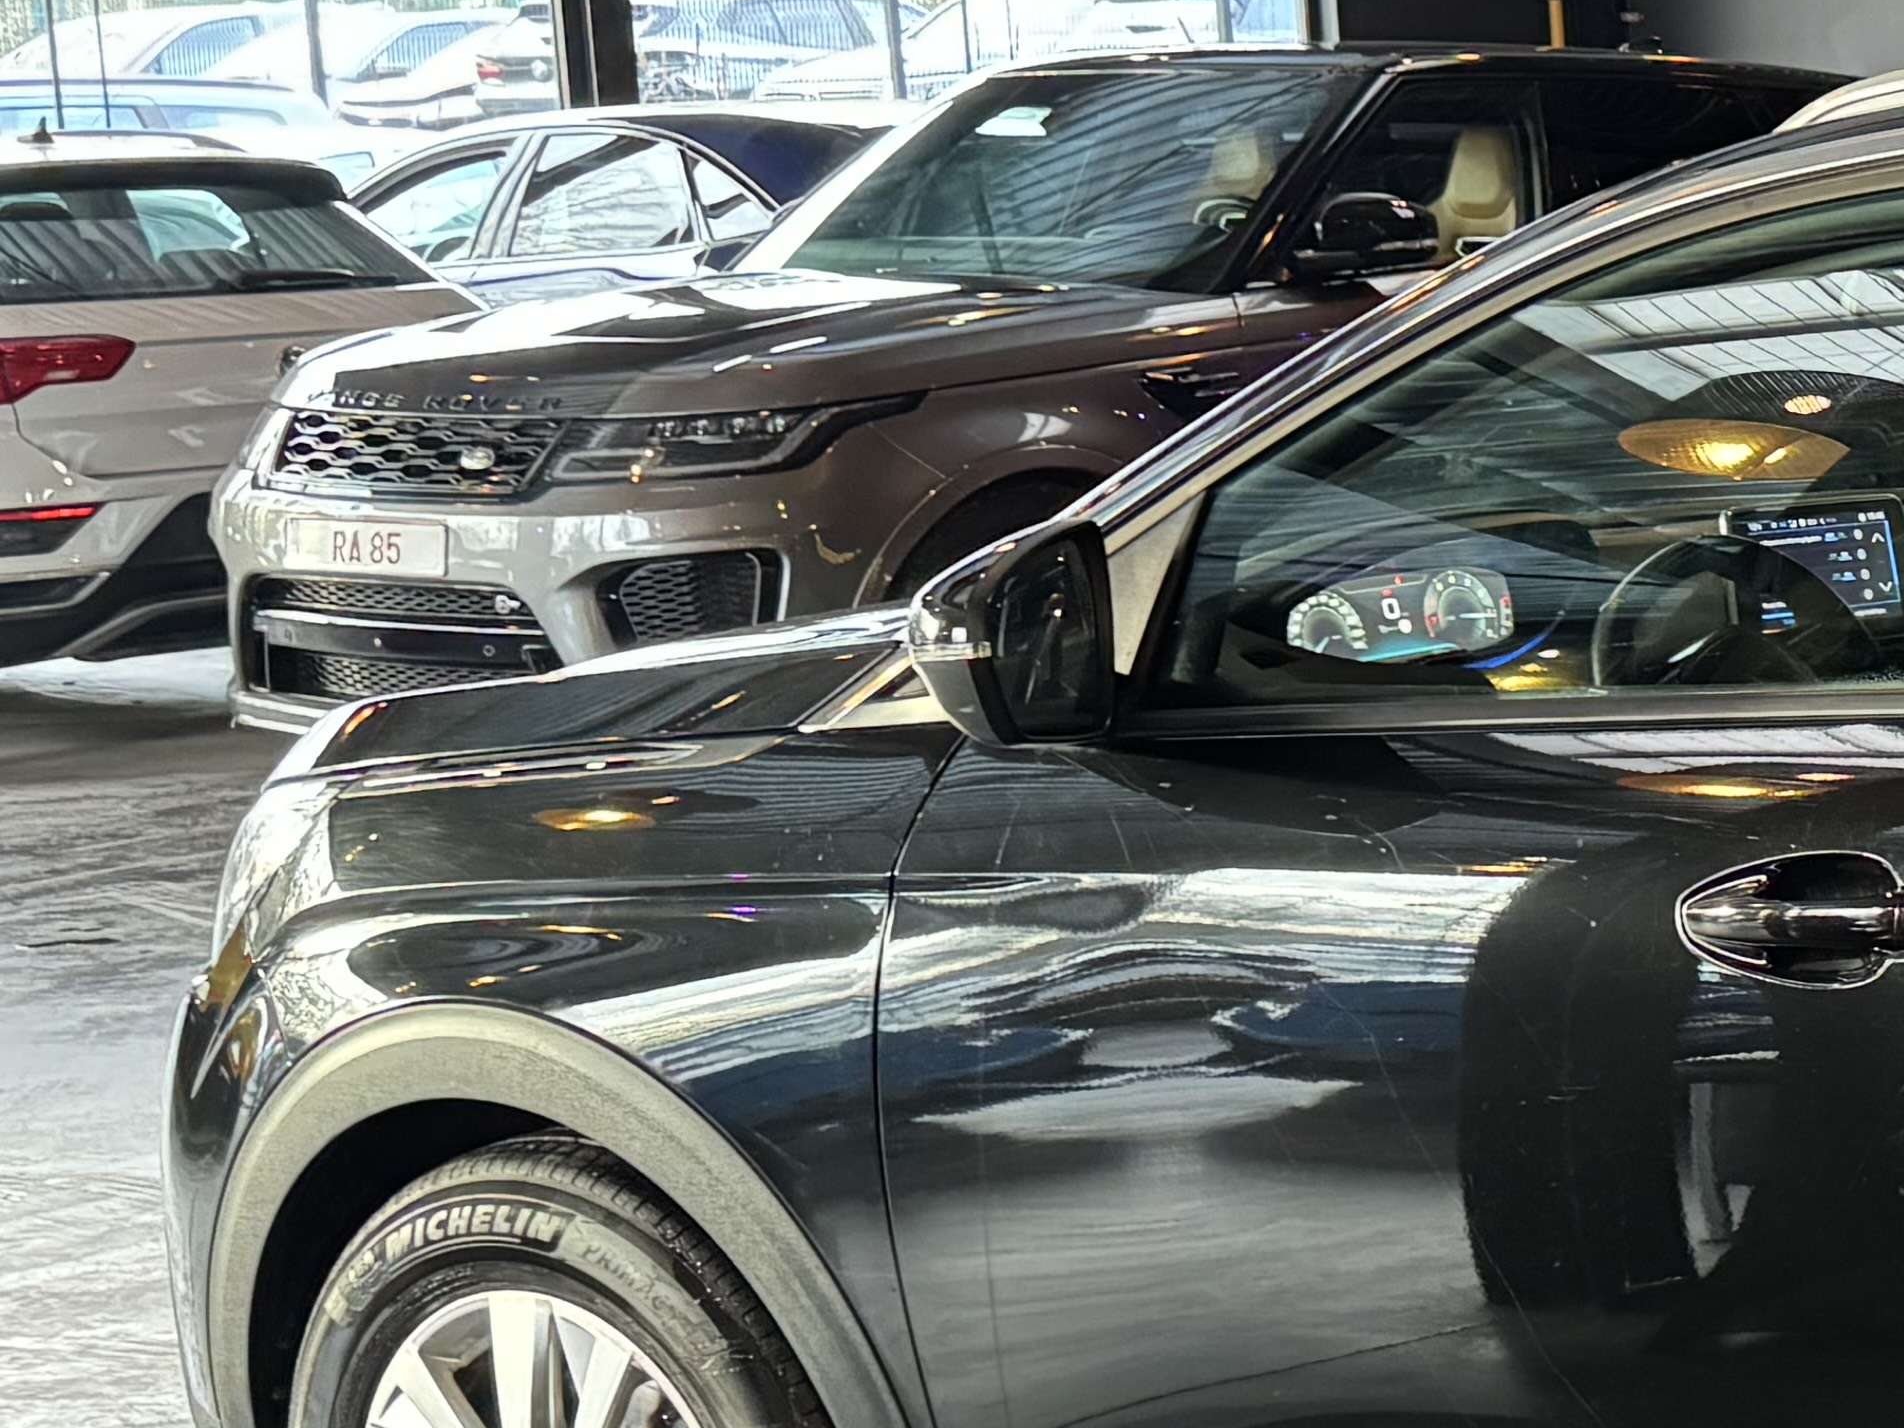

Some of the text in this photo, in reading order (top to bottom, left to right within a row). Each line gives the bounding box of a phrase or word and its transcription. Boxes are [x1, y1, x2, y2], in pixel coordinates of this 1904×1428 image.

[332, 530, 402, 564] RA 85
[385, 1204, 561, 1259] MICHELIN
